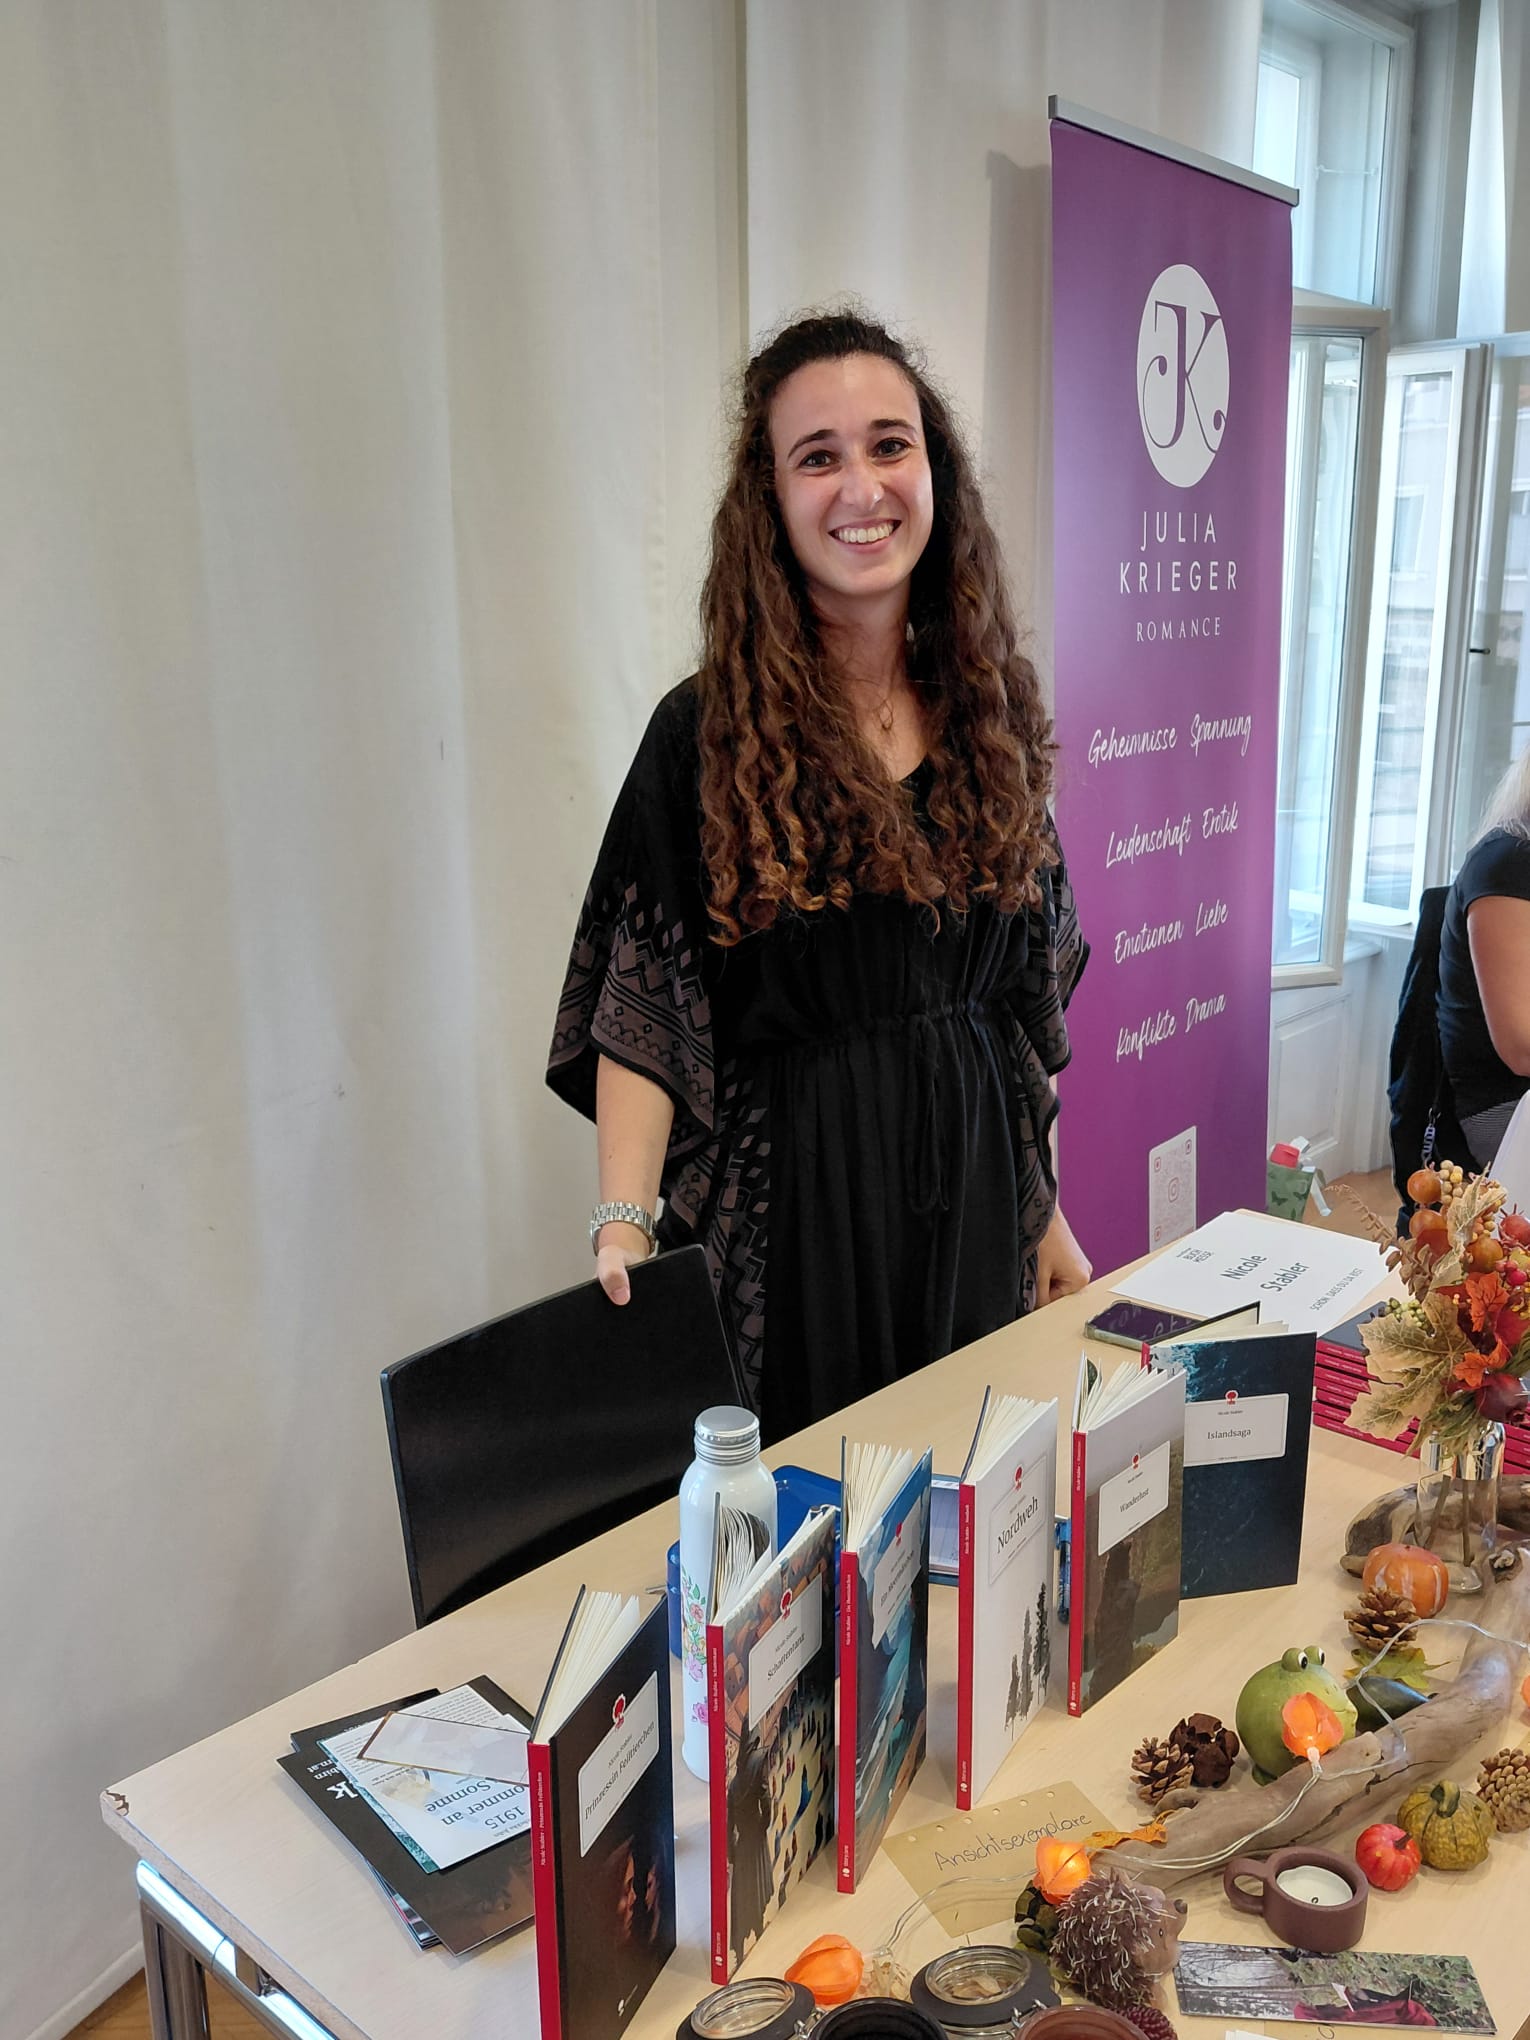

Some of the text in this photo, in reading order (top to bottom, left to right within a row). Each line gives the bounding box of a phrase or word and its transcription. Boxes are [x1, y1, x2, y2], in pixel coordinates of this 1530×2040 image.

[1140, 511, 1216, 552] JULIA
[1120, 561, 1237, 594] KRIEGER
[1136, 617, 1221, 642] ROMANCE
[1088, 713, 1252, 769] Geheimnisse Spannung
[1106, 801, 1239, 869] Leidenschaft Erotik
[1114, 899, 1229, 964] Emotionen Liebe
[1116, 994, 1226, 1063] Konflikte Drama
[1220, 1255, 1268, 1280] Nicole
[1260, 1262, 1310, 1292] Stabler
[1207, 1428, 1252, 1440] Islandsaga
[1119, 1487, 1150, 1513] Wanderlust
[997, 1496, 1039, 1554] Nordweh
[767, 1633, 806, 1680] Schattentanz
[585, 1770, 619, 1819] Prinzessin
[619, 1723, 655, 1773] Felltierchen
[425, 1780, 492, 1813] Somme
[441, 1785, 526, 1825] ommer an
[484, 1805, 526, 1830] 1915
[934, 1812, 1092, 1871] Ansichtsexemplare
